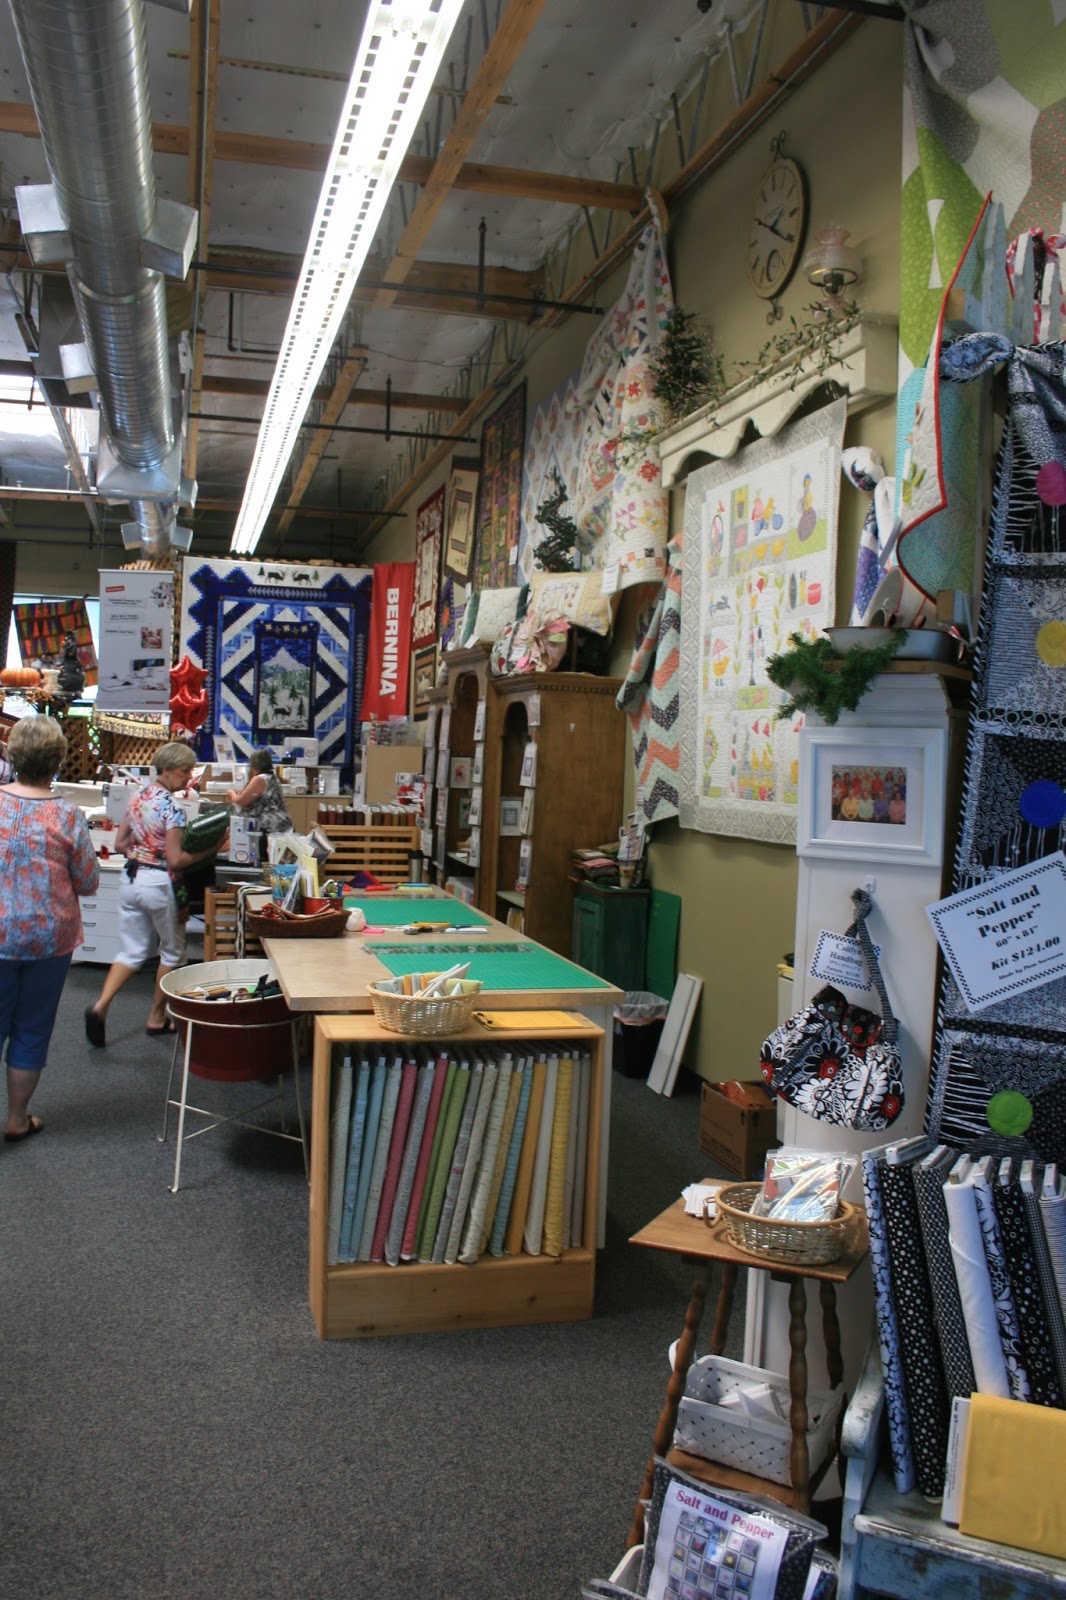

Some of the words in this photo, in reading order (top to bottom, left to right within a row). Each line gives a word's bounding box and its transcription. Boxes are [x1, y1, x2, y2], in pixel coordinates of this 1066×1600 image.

[379, 588, 399, 696] BERNINA
[966, 900, 1006, 919] "Salt
[1011, 884, 1040, 905] and
[977, 903, 1041, 938] Pepper"
[991, 957, 1008, 971] Kit
[676, 1490, 702, 1509] Salt
[703, 1504, 728, 1521] and
[731, 1513, 774, 1540] Pepper
